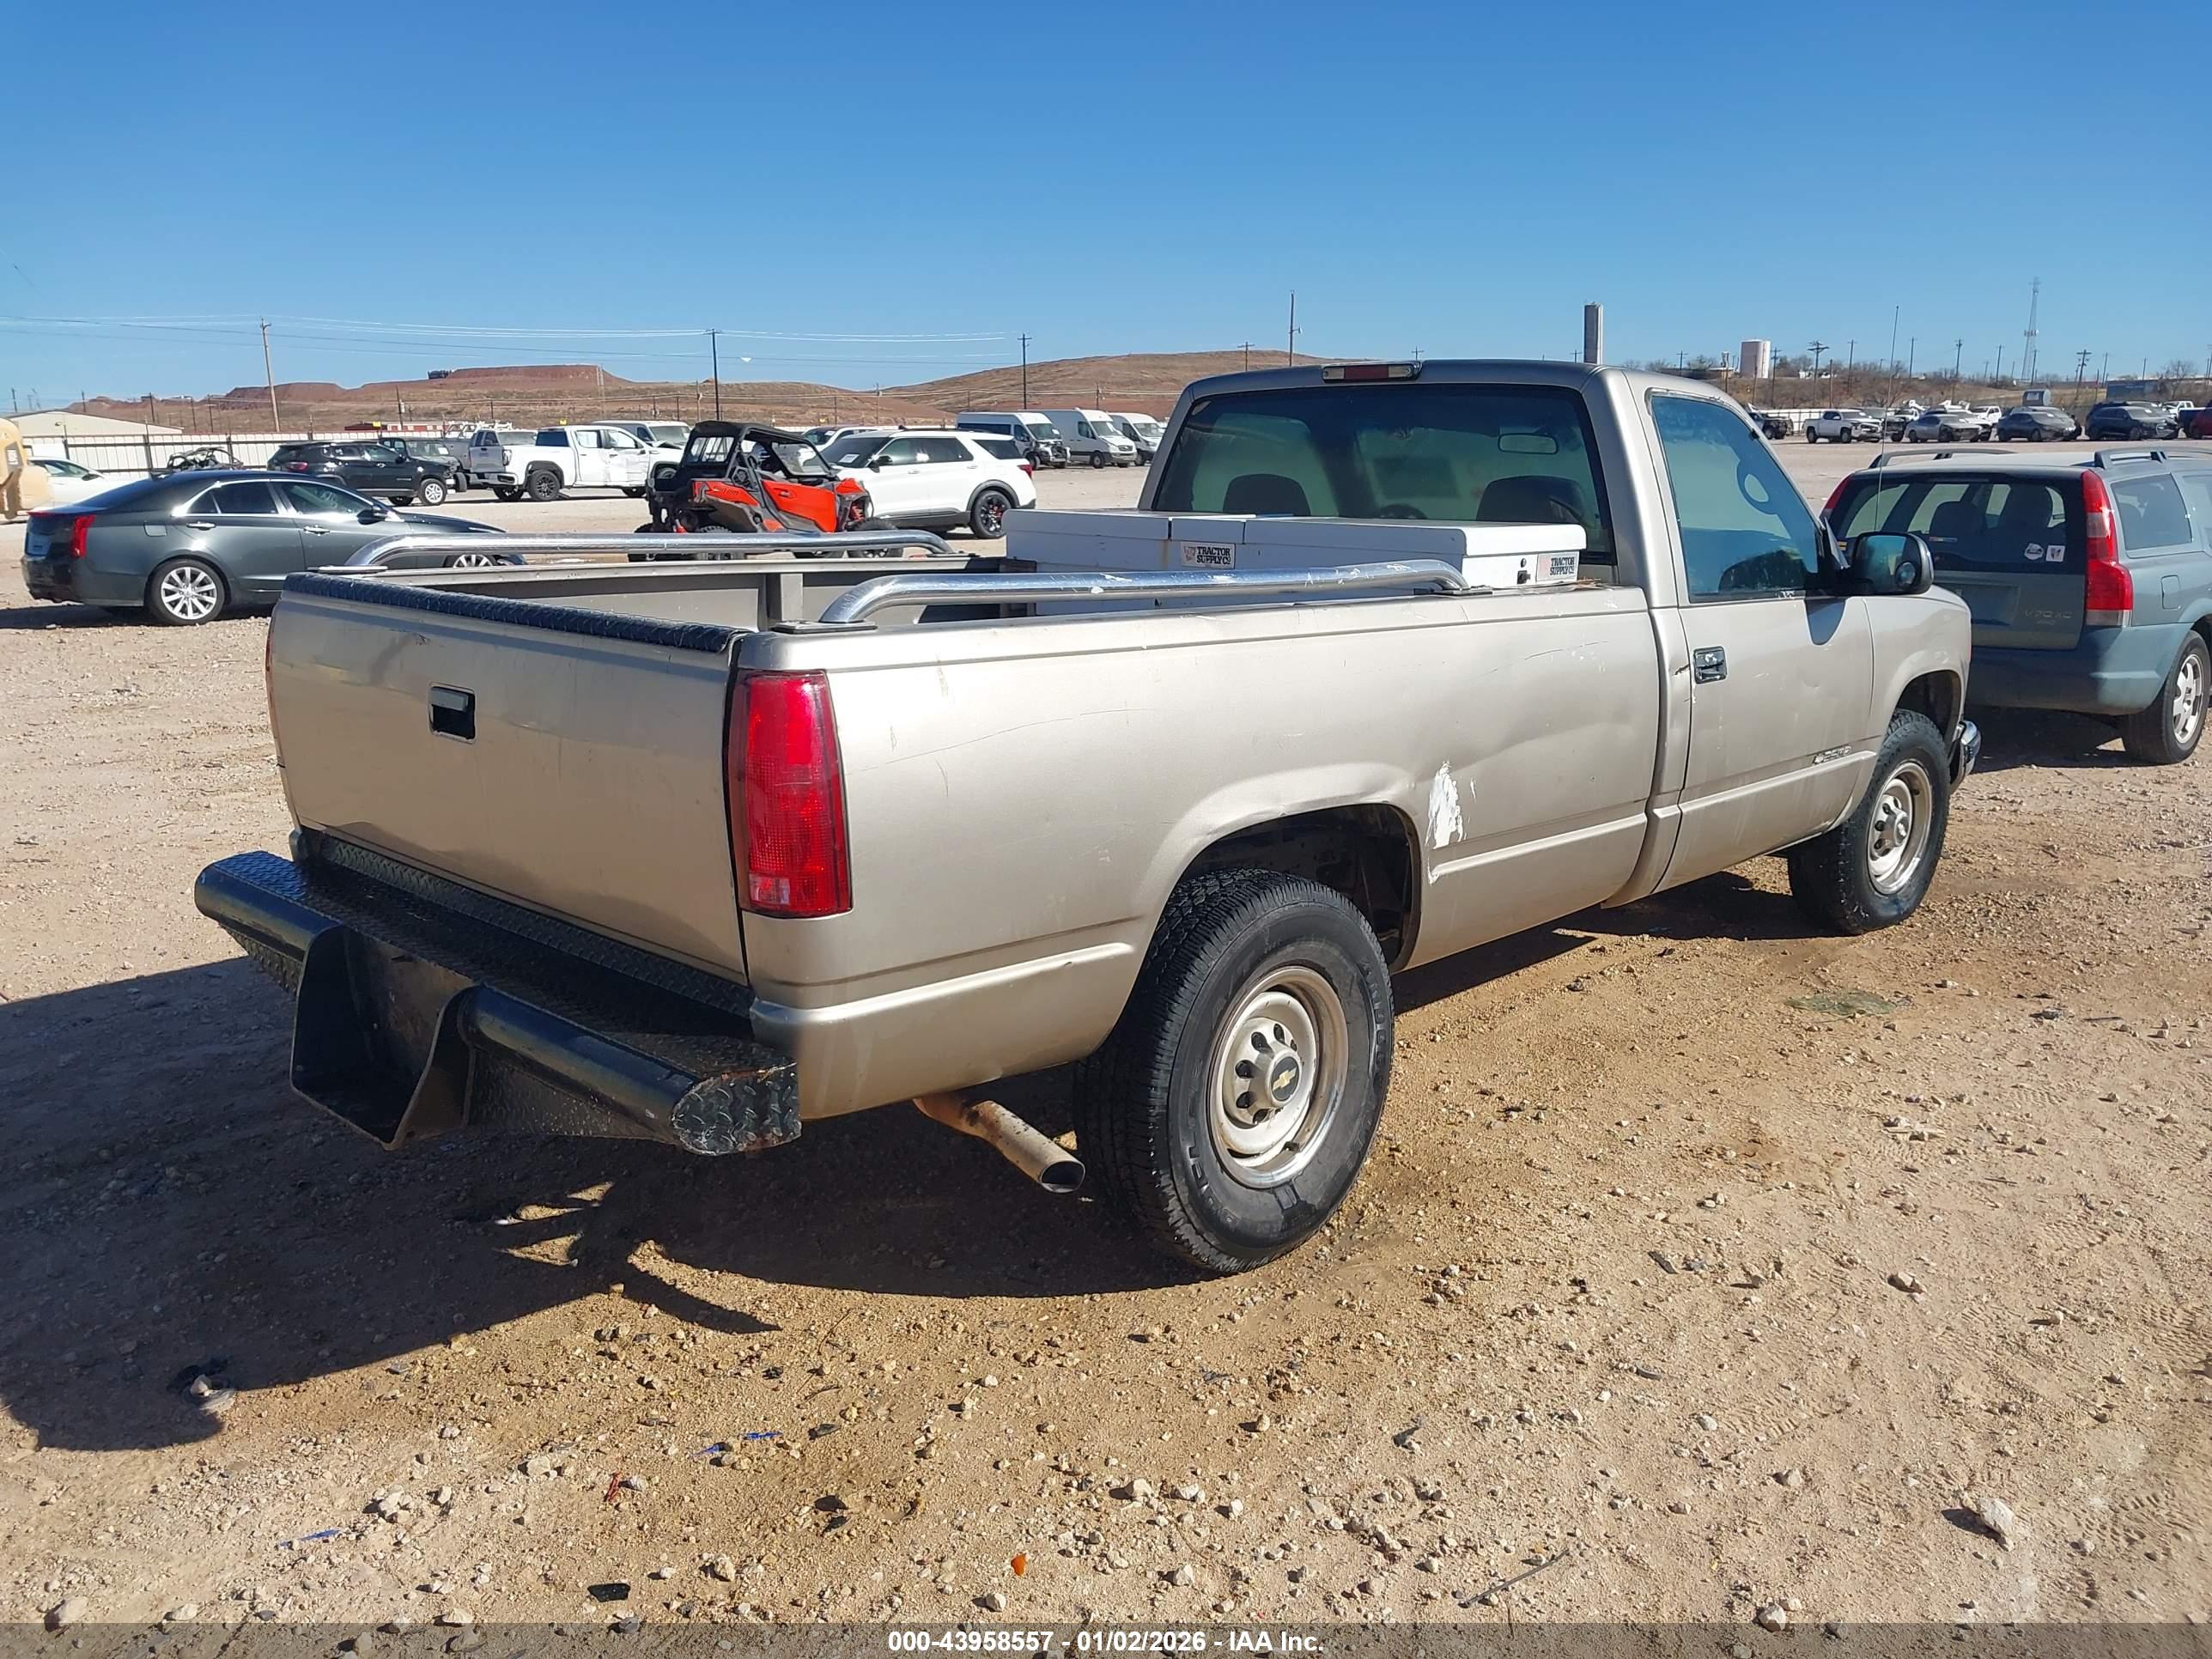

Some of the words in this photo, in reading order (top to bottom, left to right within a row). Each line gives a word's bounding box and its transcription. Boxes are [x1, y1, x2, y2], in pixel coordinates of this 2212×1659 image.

[1197, 546, 1231, 556] TRACTOR
[1196, 555, 1223, 564] SUPPLY
[1550, 556, 1575, 567] TRACTOR
[1549, 566, 1569, 576] SUPPLY
